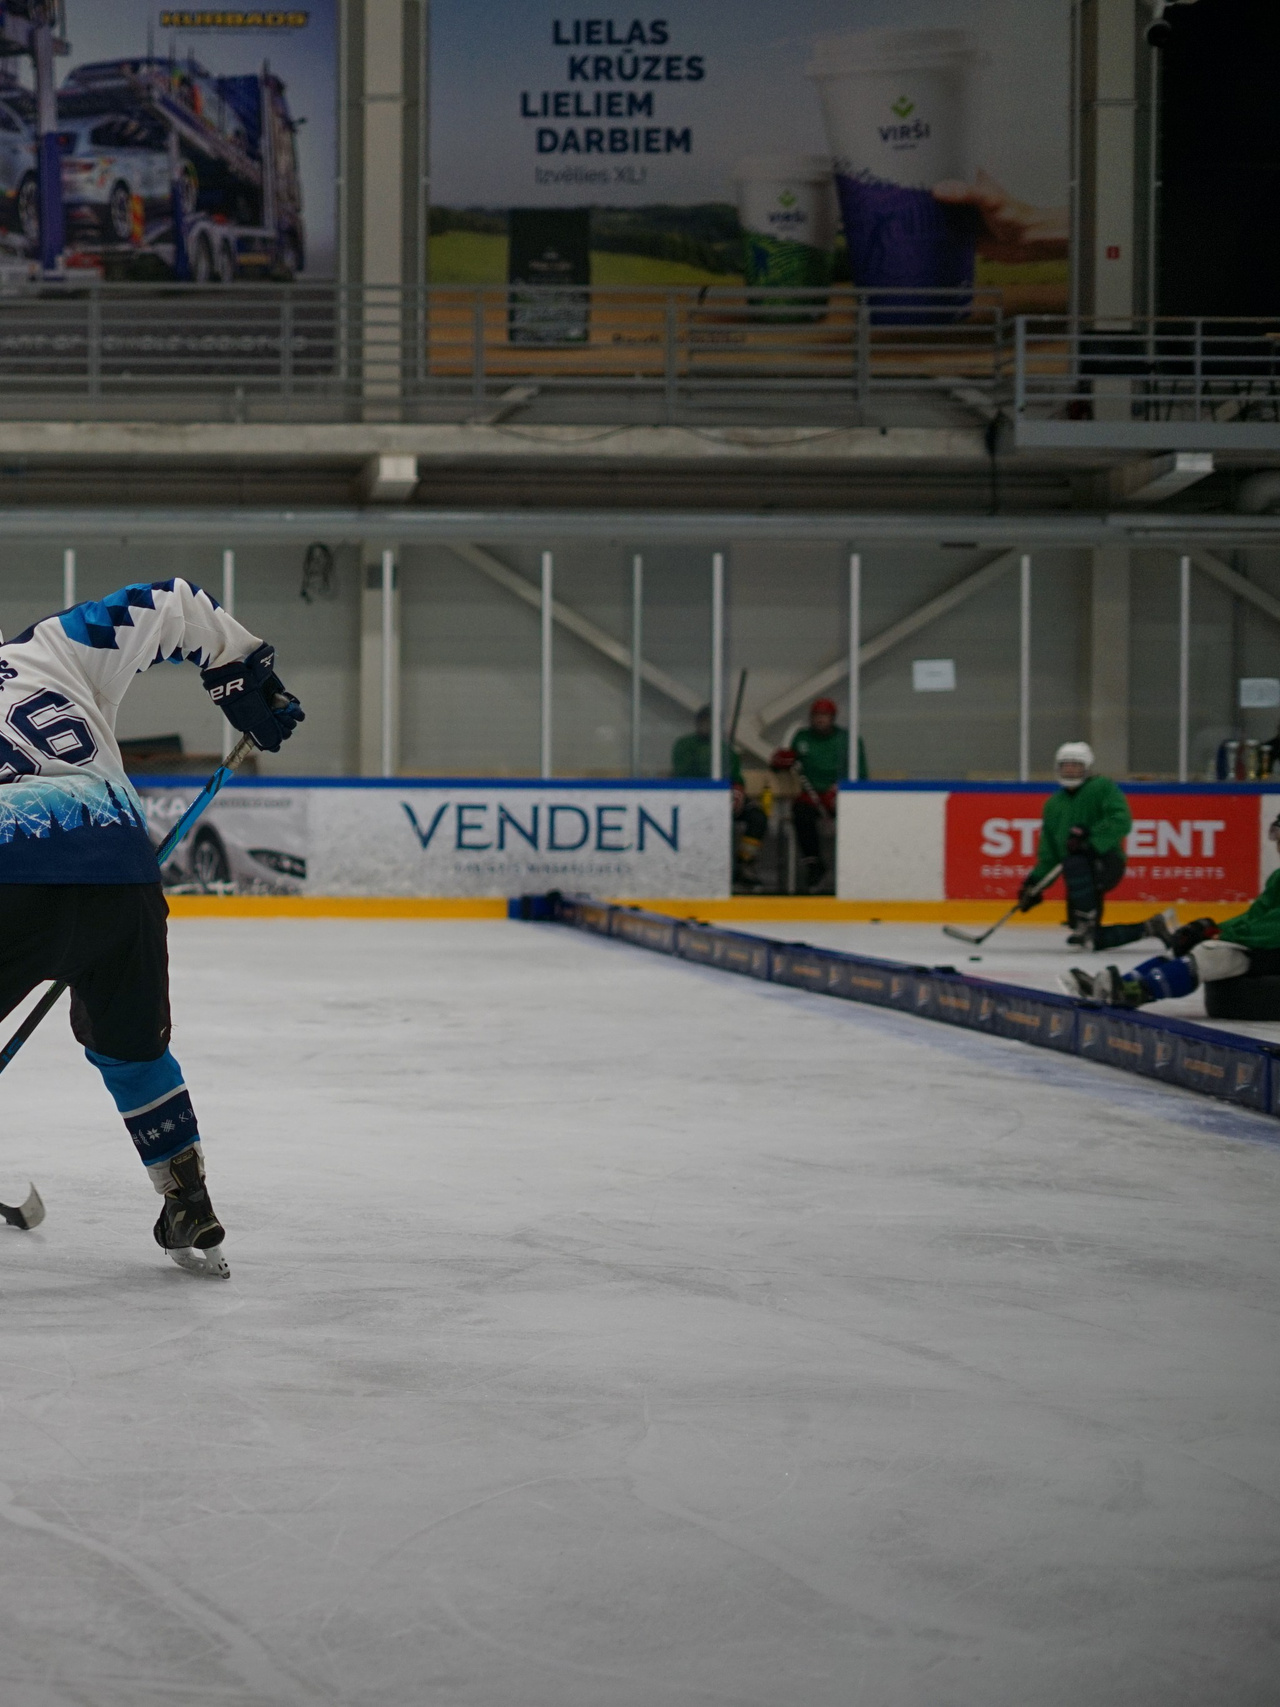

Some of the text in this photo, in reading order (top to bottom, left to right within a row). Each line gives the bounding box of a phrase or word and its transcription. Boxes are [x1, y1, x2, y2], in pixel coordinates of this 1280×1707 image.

[553, 19, 668, 45] LIELAS
[570, 48, 705, 81] KRŪZES
[522, 91, 652, 117] LIELIEM
[536, 127, 692, 153] DARBIEM
[402, 801, 680, 852] VENDEN
[980, 817, 1226, 858] STENT
[1153, 866, 1226, 880] EXPERTS
